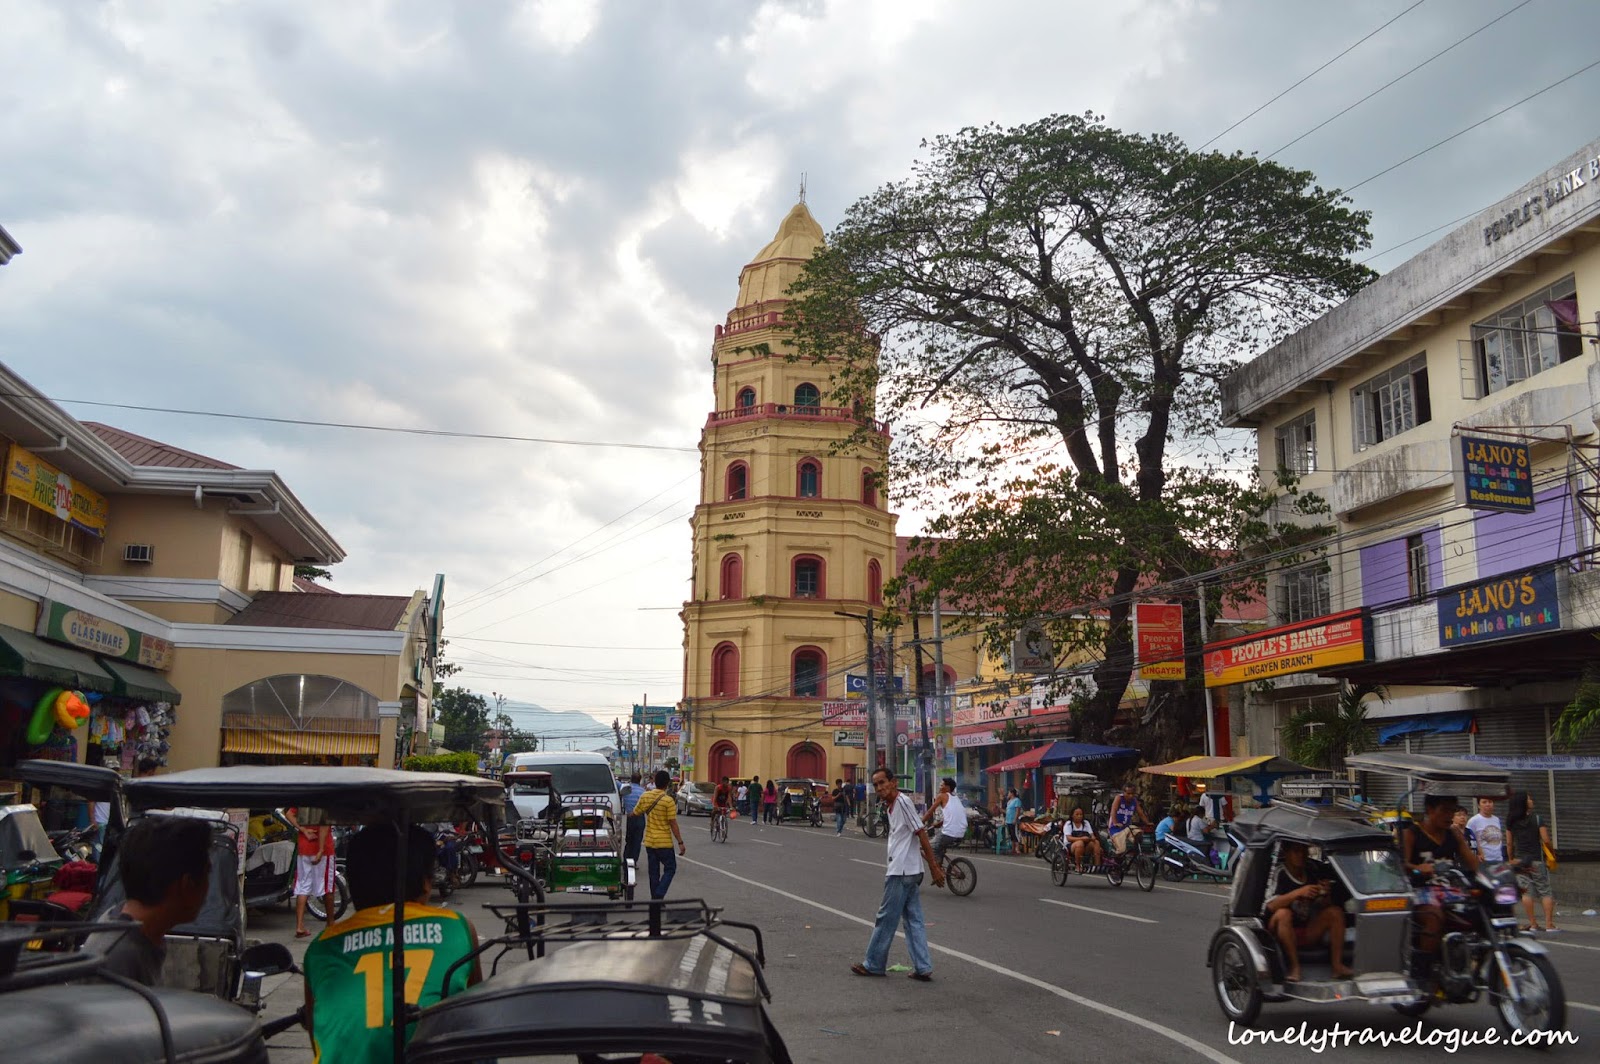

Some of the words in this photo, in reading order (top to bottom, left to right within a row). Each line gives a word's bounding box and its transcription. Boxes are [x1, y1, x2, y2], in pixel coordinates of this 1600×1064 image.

[1483, 196, 1542, 246] PEOPLE'S
[1544, 167, 1586, 208] BANK
[1466, 442, 1528, 467] JANO'S
[1469, 463, 1528, 480] Halo-Halo
[33, 480, 57, 509] PRICE
[1481, 477, 1528, 492] Palab
[1470, 489, 1532, 506] Restaurant
[1456, 574, 1536, 618] JANO'S
[1496, 616, 1505, 631] &
[71, 622, 123, 649] GLASSWARE
[1143, 635, 1178, 643] PEOPLE'S
[1150, 643, 1172, 651] BANK
[1231, 635, 1287, 663] PEOPLE'S
[1290, 626, 1327, 651] BANK
[1142, 667, 1182, 675] LINGAYEN
[1244, 661, 1279, 677] LINGAYEN
[1281, 654, 1313, 670] BRANCH
[956, 735, 984, 746] index
[343, 927, 382, 954] DELOS
[385, 922, 443, 945] AGELES
[353, 948, 434, 1029] 17
